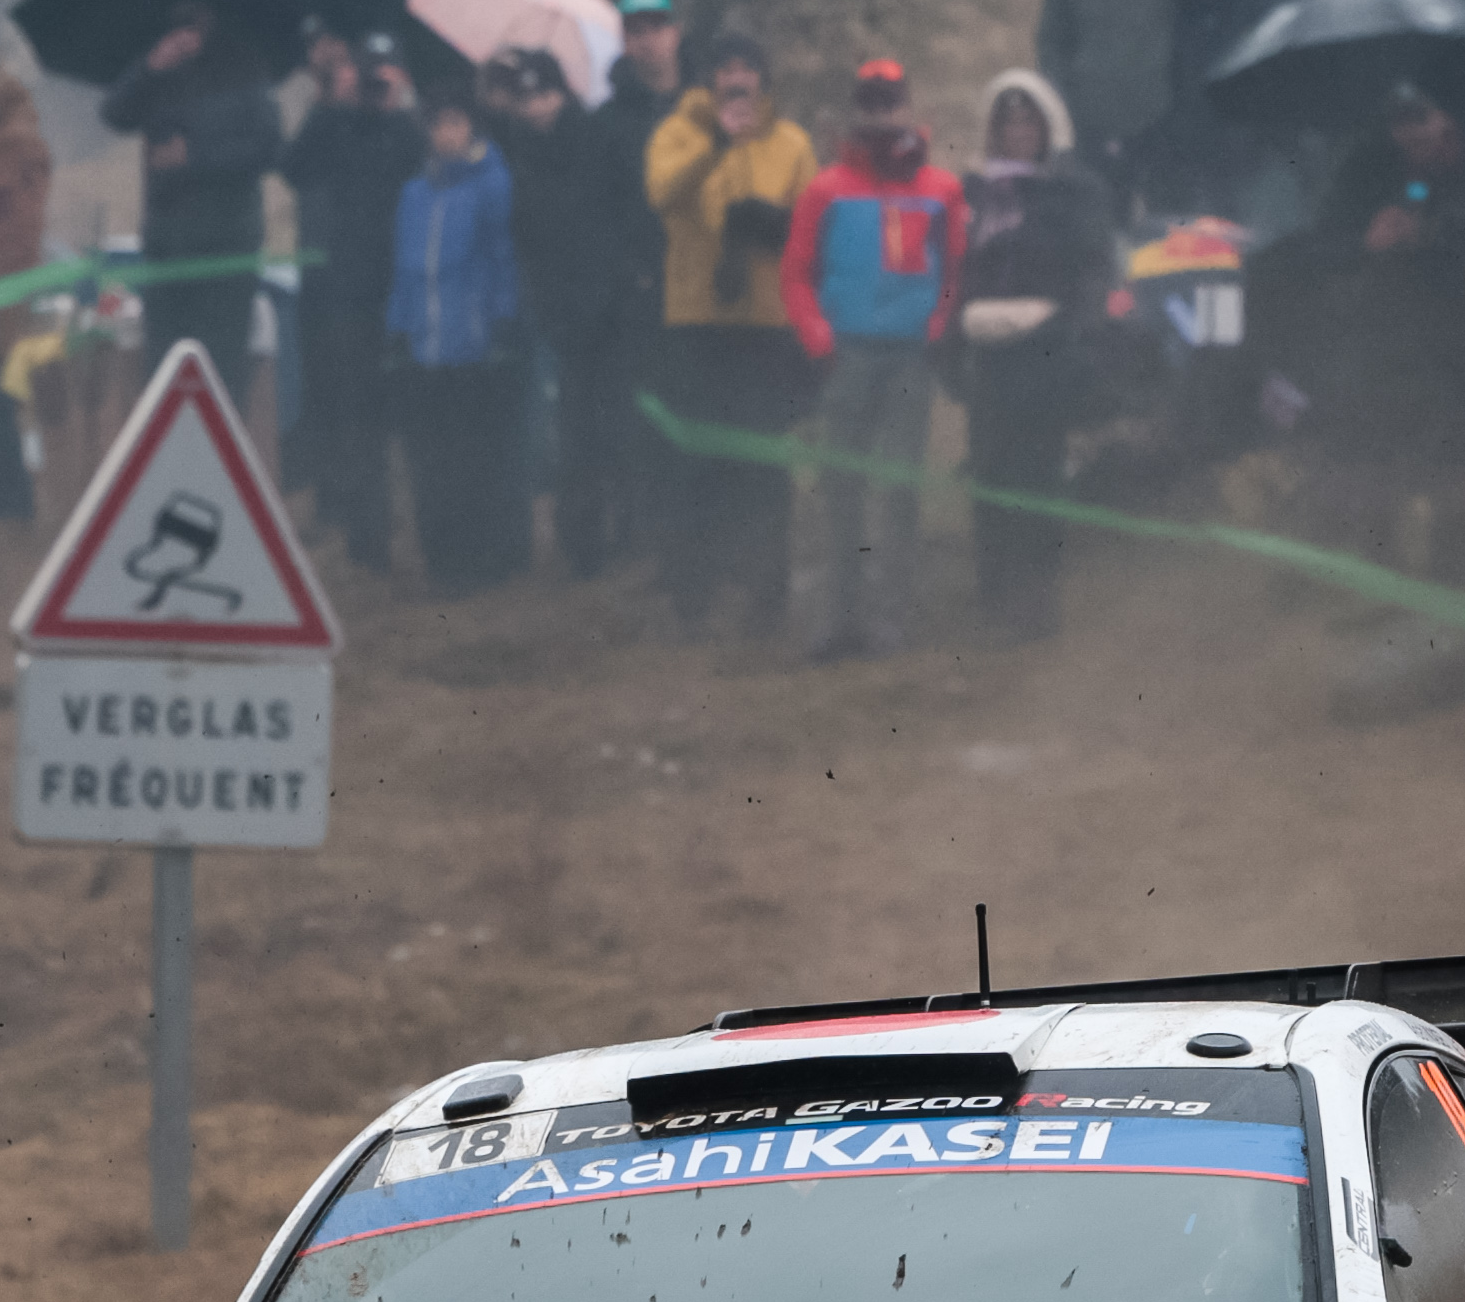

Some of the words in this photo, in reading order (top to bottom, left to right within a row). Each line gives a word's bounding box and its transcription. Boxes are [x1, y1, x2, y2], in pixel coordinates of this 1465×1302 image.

[61, 695, 293, 741] VERGLAS
[39, 757, 306, 811] FRÉQUENT
[556, 1106, 778, 1145] TOYOTA
[793, 1095, 1004, 1118] GAZOO
[1014, 1093, 1212, 1116] Racing
[428, 1122, 512, 1169] 18
